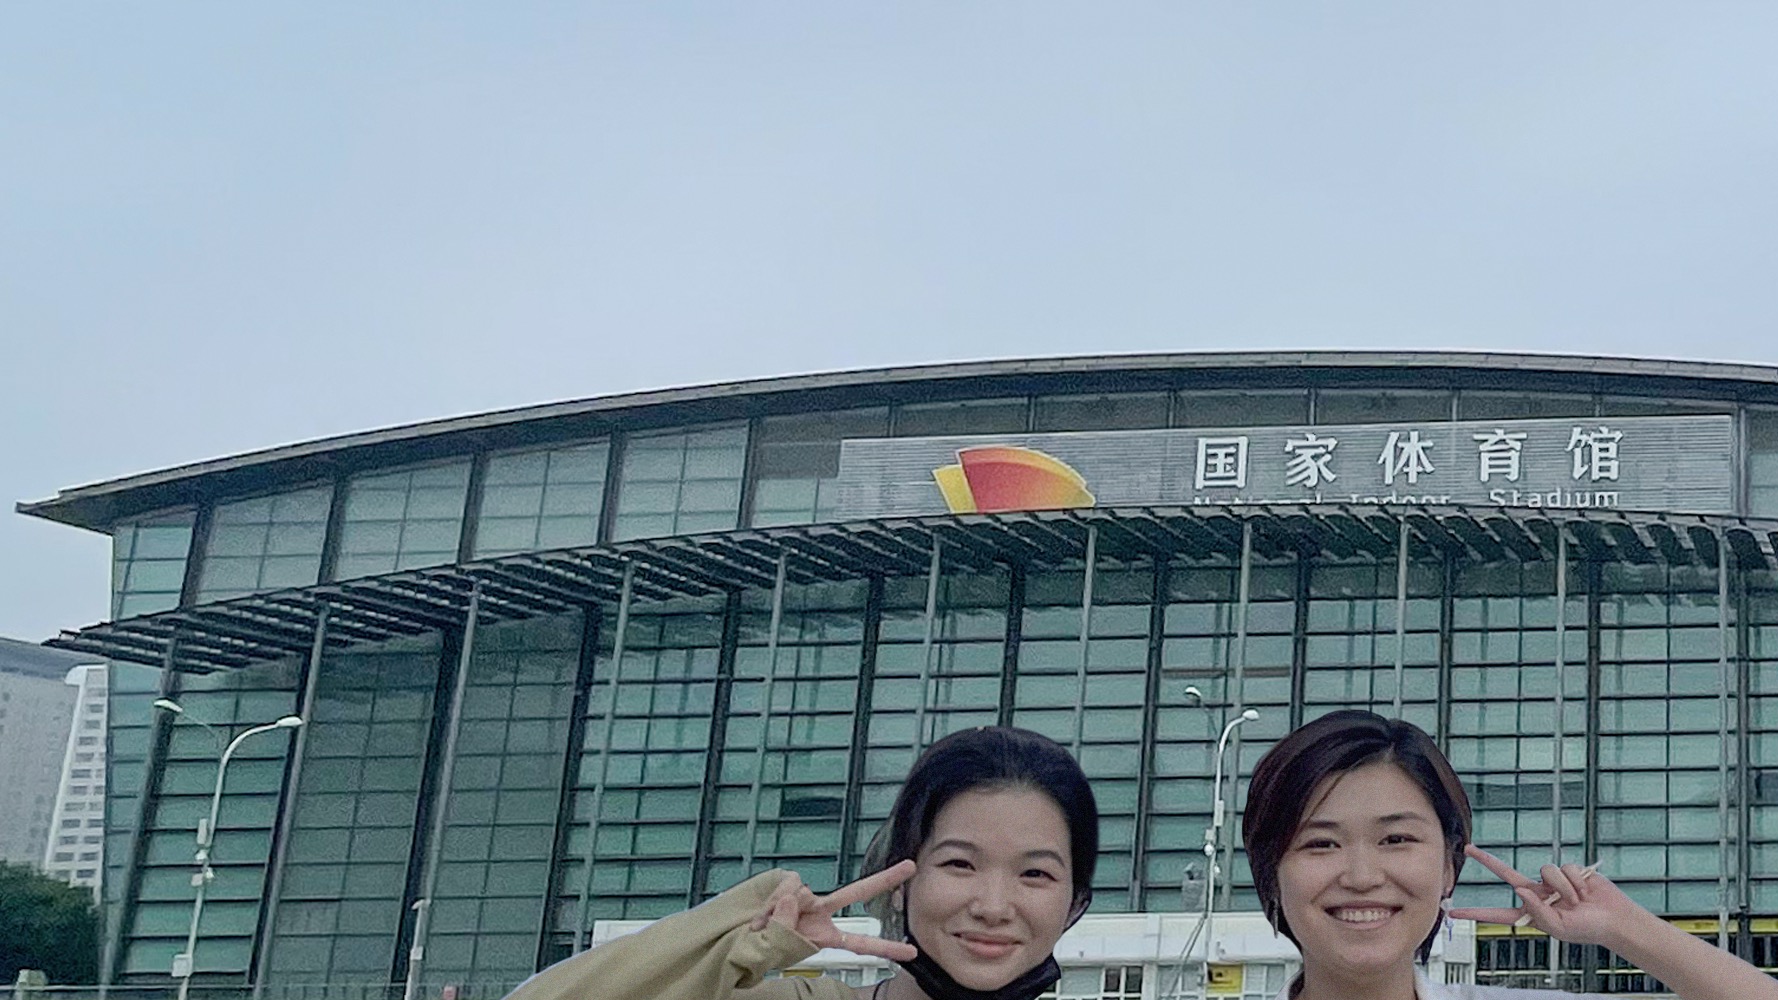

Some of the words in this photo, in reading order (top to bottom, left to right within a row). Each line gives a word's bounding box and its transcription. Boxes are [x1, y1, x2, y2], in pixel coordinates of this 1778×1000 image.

[1194, 427, 1623, 489] 国家体育馆
[1489, 487, 1618, 508] Stadium
